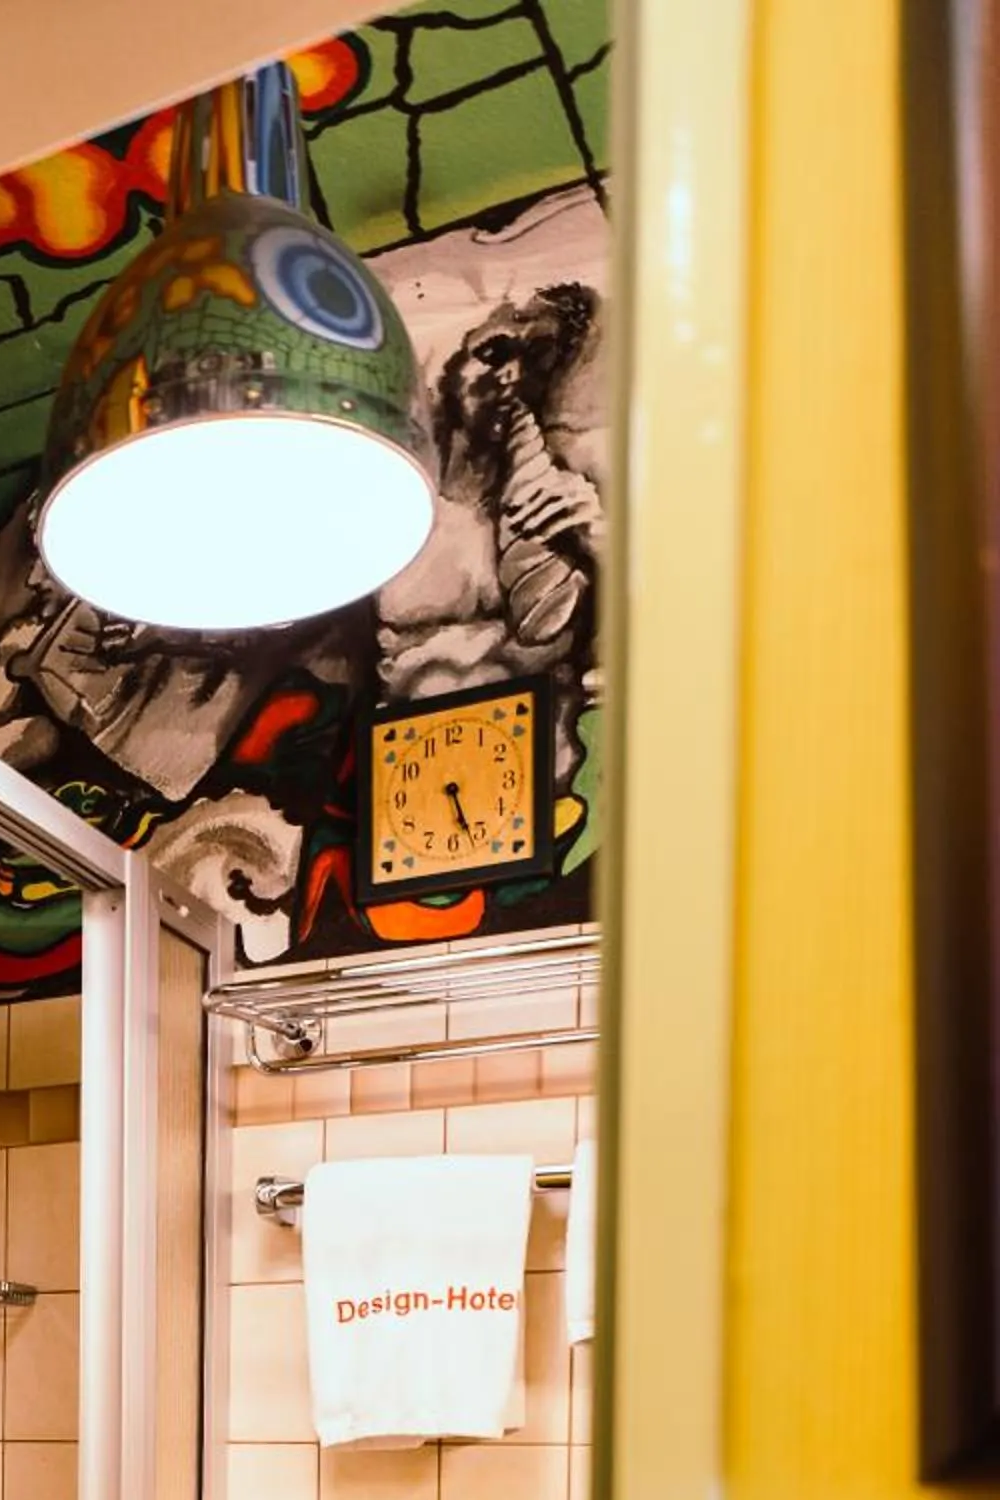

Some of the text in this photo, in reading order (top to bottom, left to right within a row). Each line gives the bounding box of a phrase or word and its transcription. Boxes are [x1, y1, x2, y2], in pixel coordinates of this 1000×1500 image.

[445, 725, 463, 747] 12
[424, 738, 436, 759] 11
[493, 743, 507, 763] 2
[402, 762, 420, 782] 10
[502, 770, 516, 790] 3
[394, 791, 407, 810] 9
[423, 831, 435, 850] 7
[473, 821, 487, 841] 5
[447, 834, 460, 853] 6
